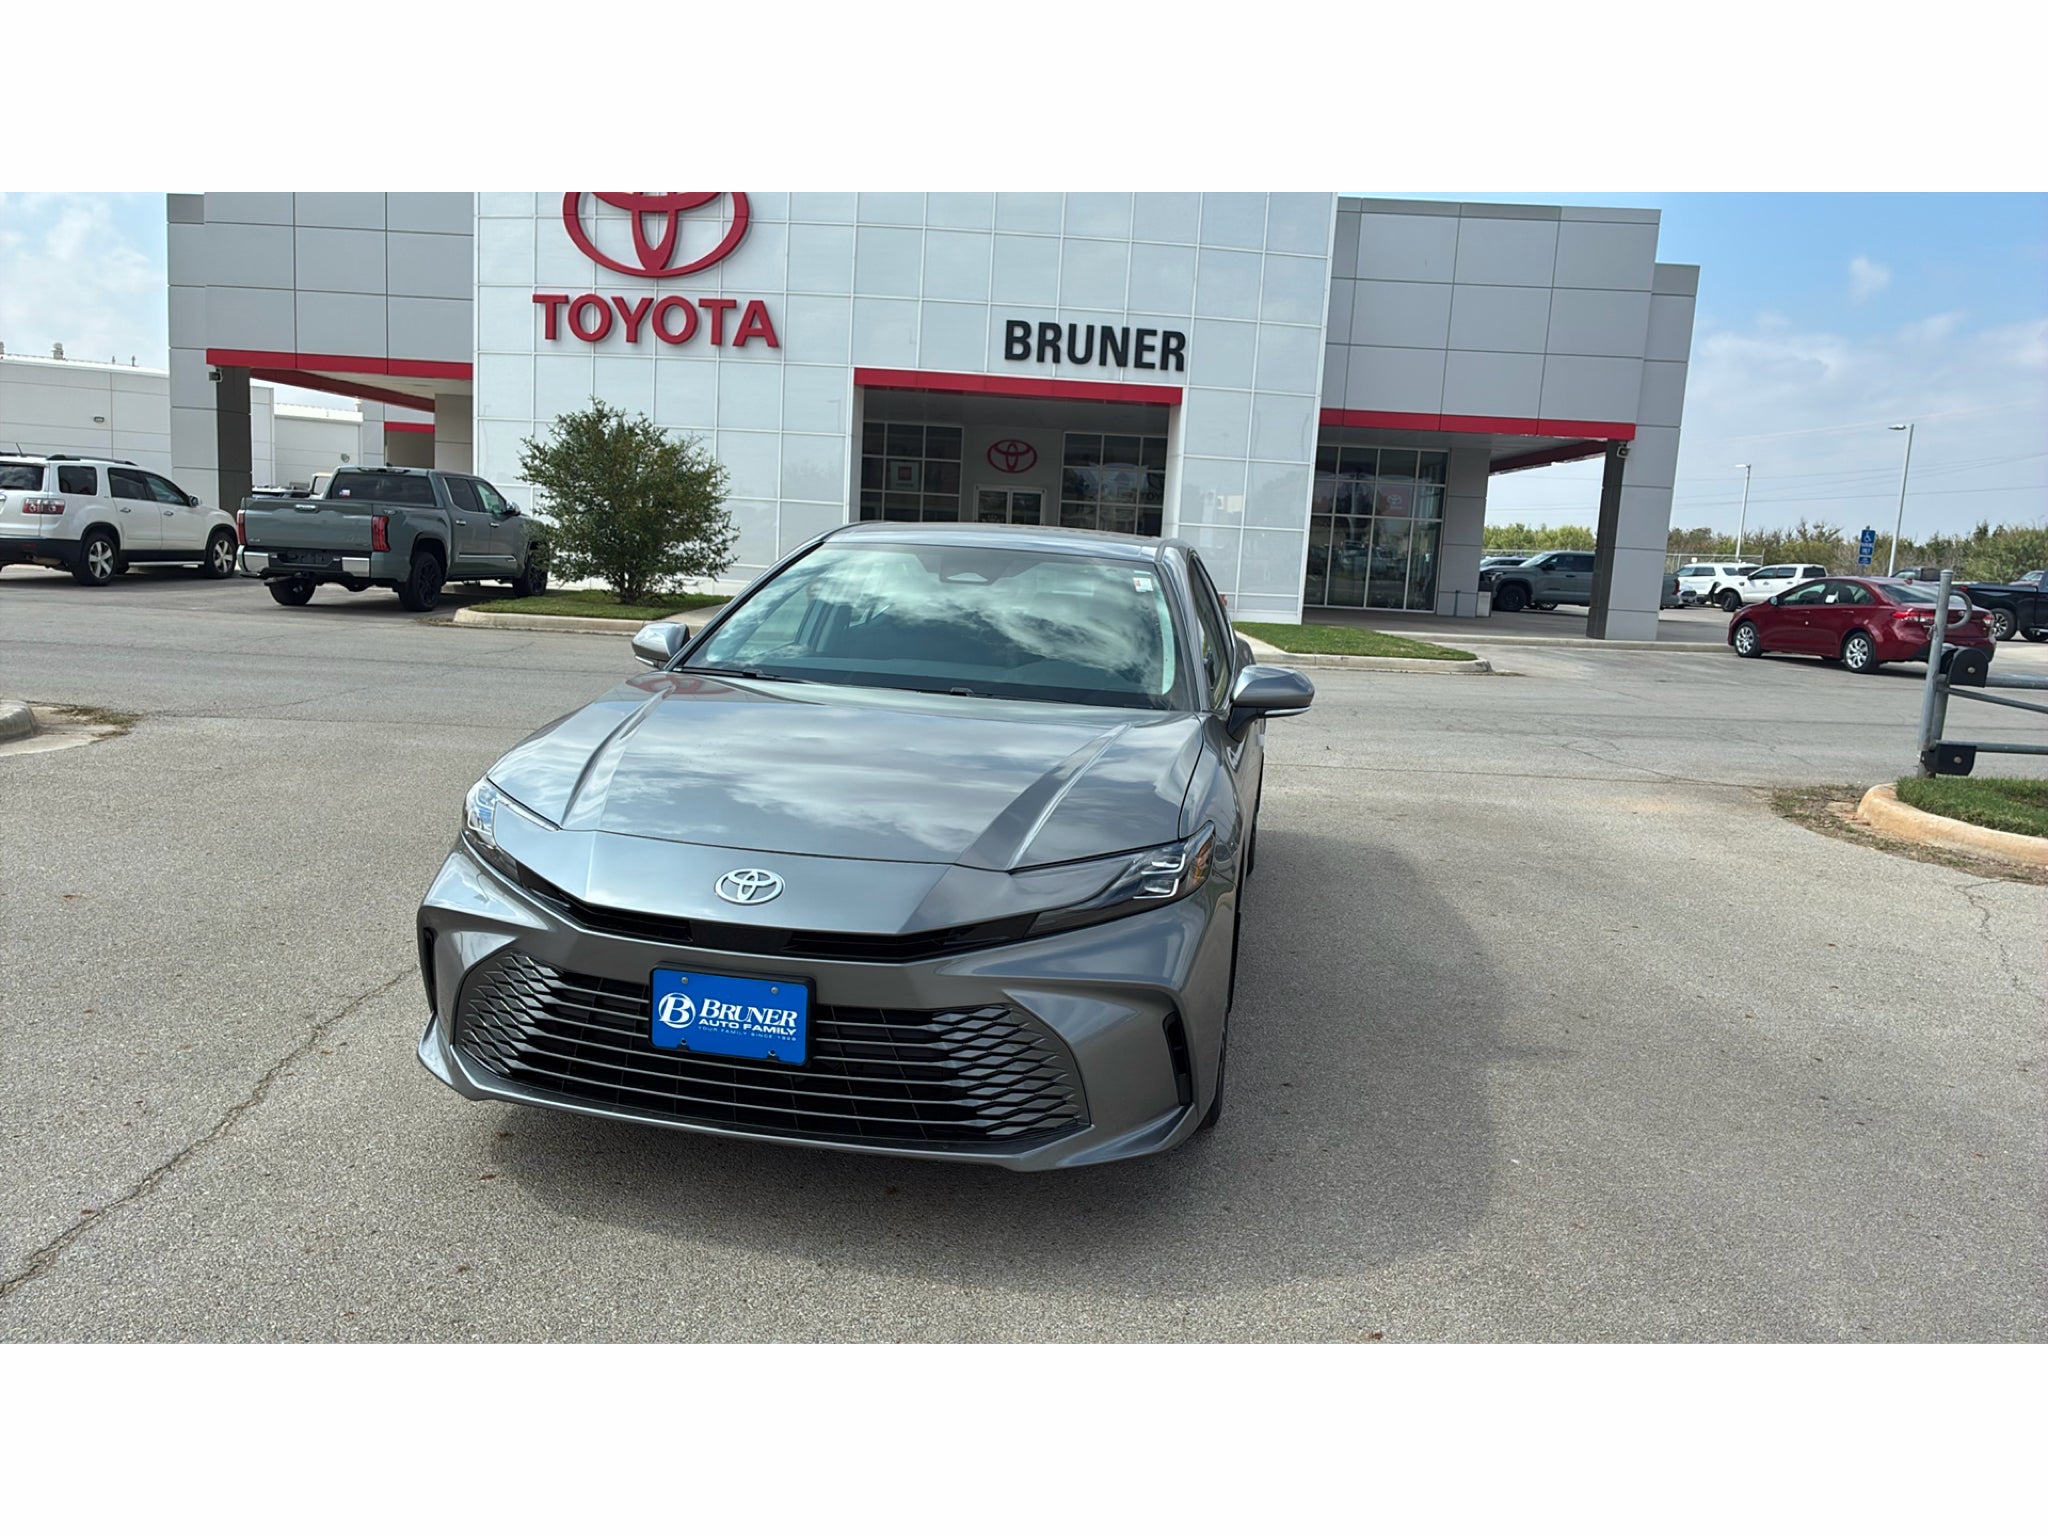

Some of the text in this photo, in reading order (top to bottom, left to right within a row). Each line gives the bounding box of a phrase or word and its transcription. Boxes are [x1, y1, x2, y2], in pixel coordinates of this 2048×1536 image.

[532, 293, 780, 348] TOYOTA
[1004, 320, 1186, 372] BRUNER
[699, 998, 798, 1027] BRUNER
[699, 1019, 797, 1036] AUTO FAMILY
[721, 1028, 747, 1036] FAMILY
